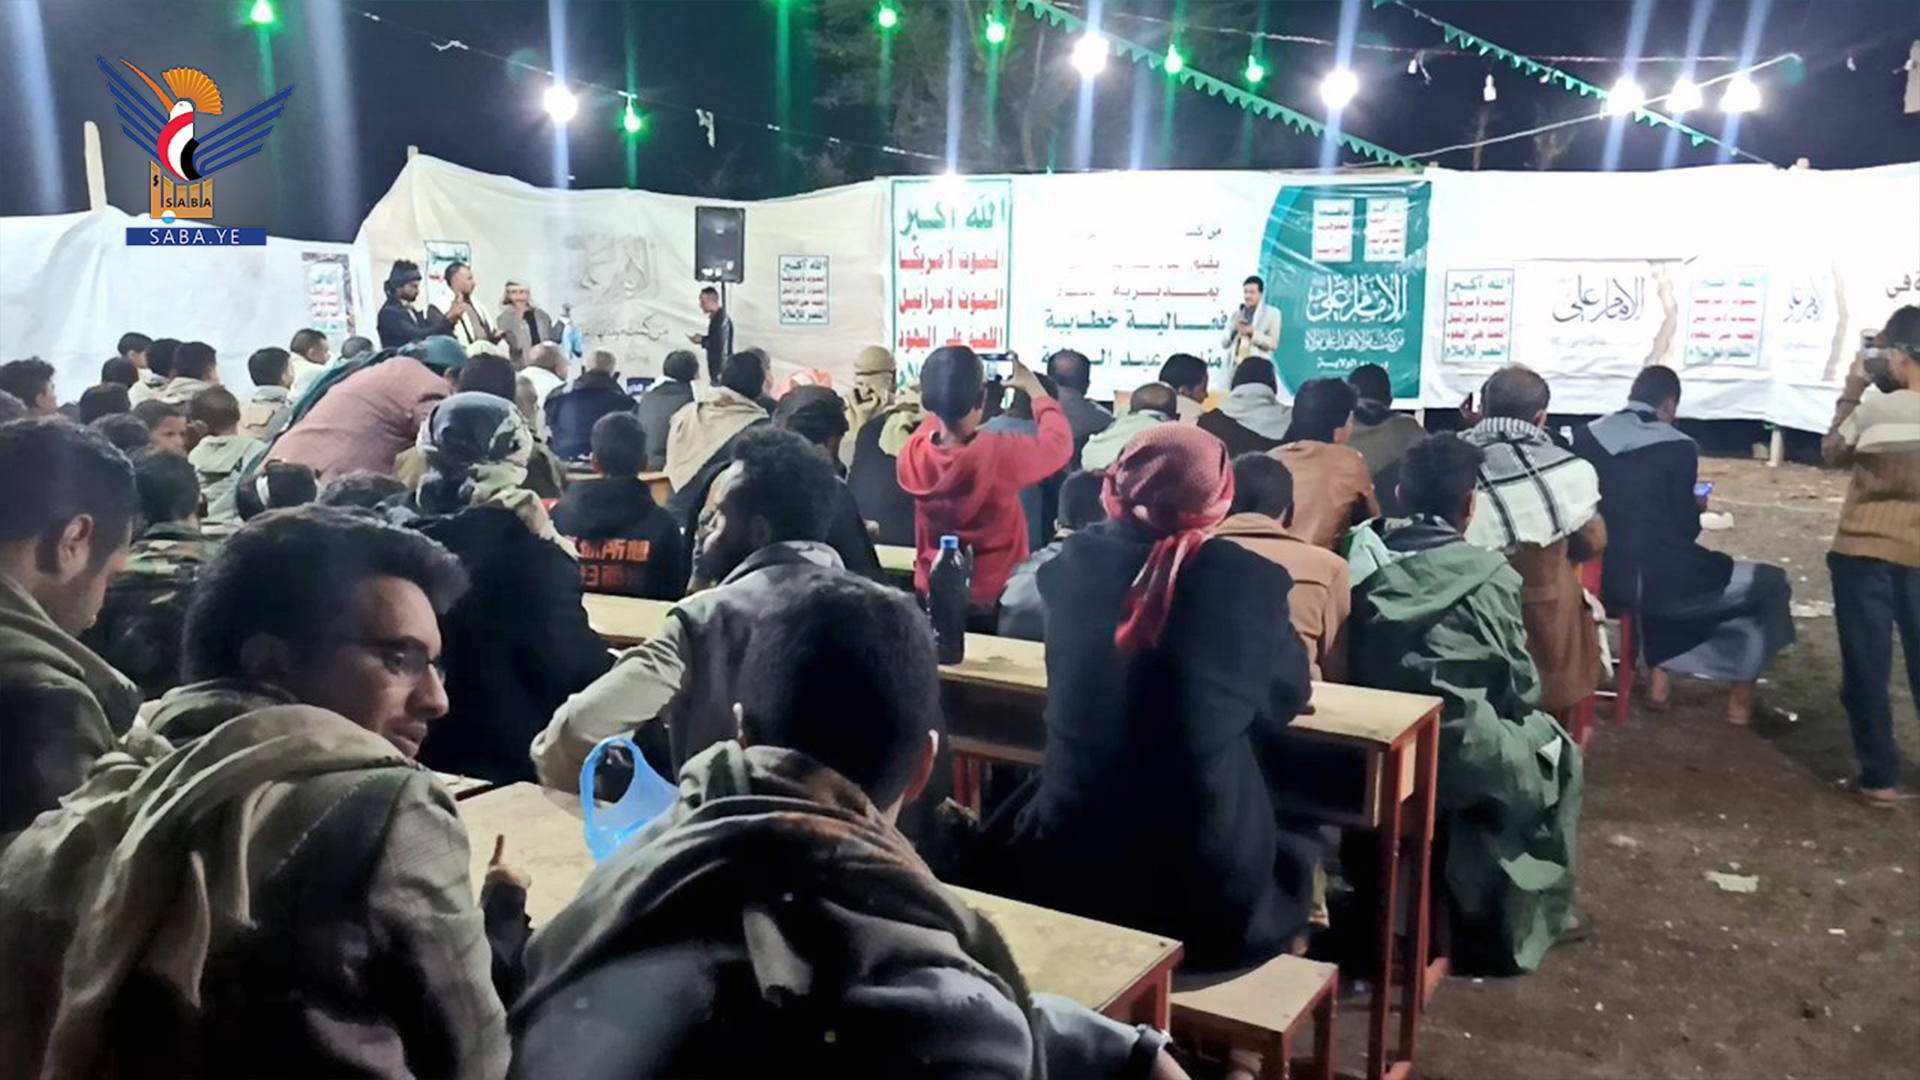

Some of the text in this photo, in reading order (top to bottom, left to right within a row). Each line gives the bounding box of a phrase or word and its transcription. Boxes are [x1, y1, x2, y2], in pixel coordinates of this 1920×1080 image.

[965, 195, 1005, 229] الله
[959, 247, 1004, 275] الموت
[958, 286, 1004, 315] الموت
[898, 325, 937, 354] اليهود
